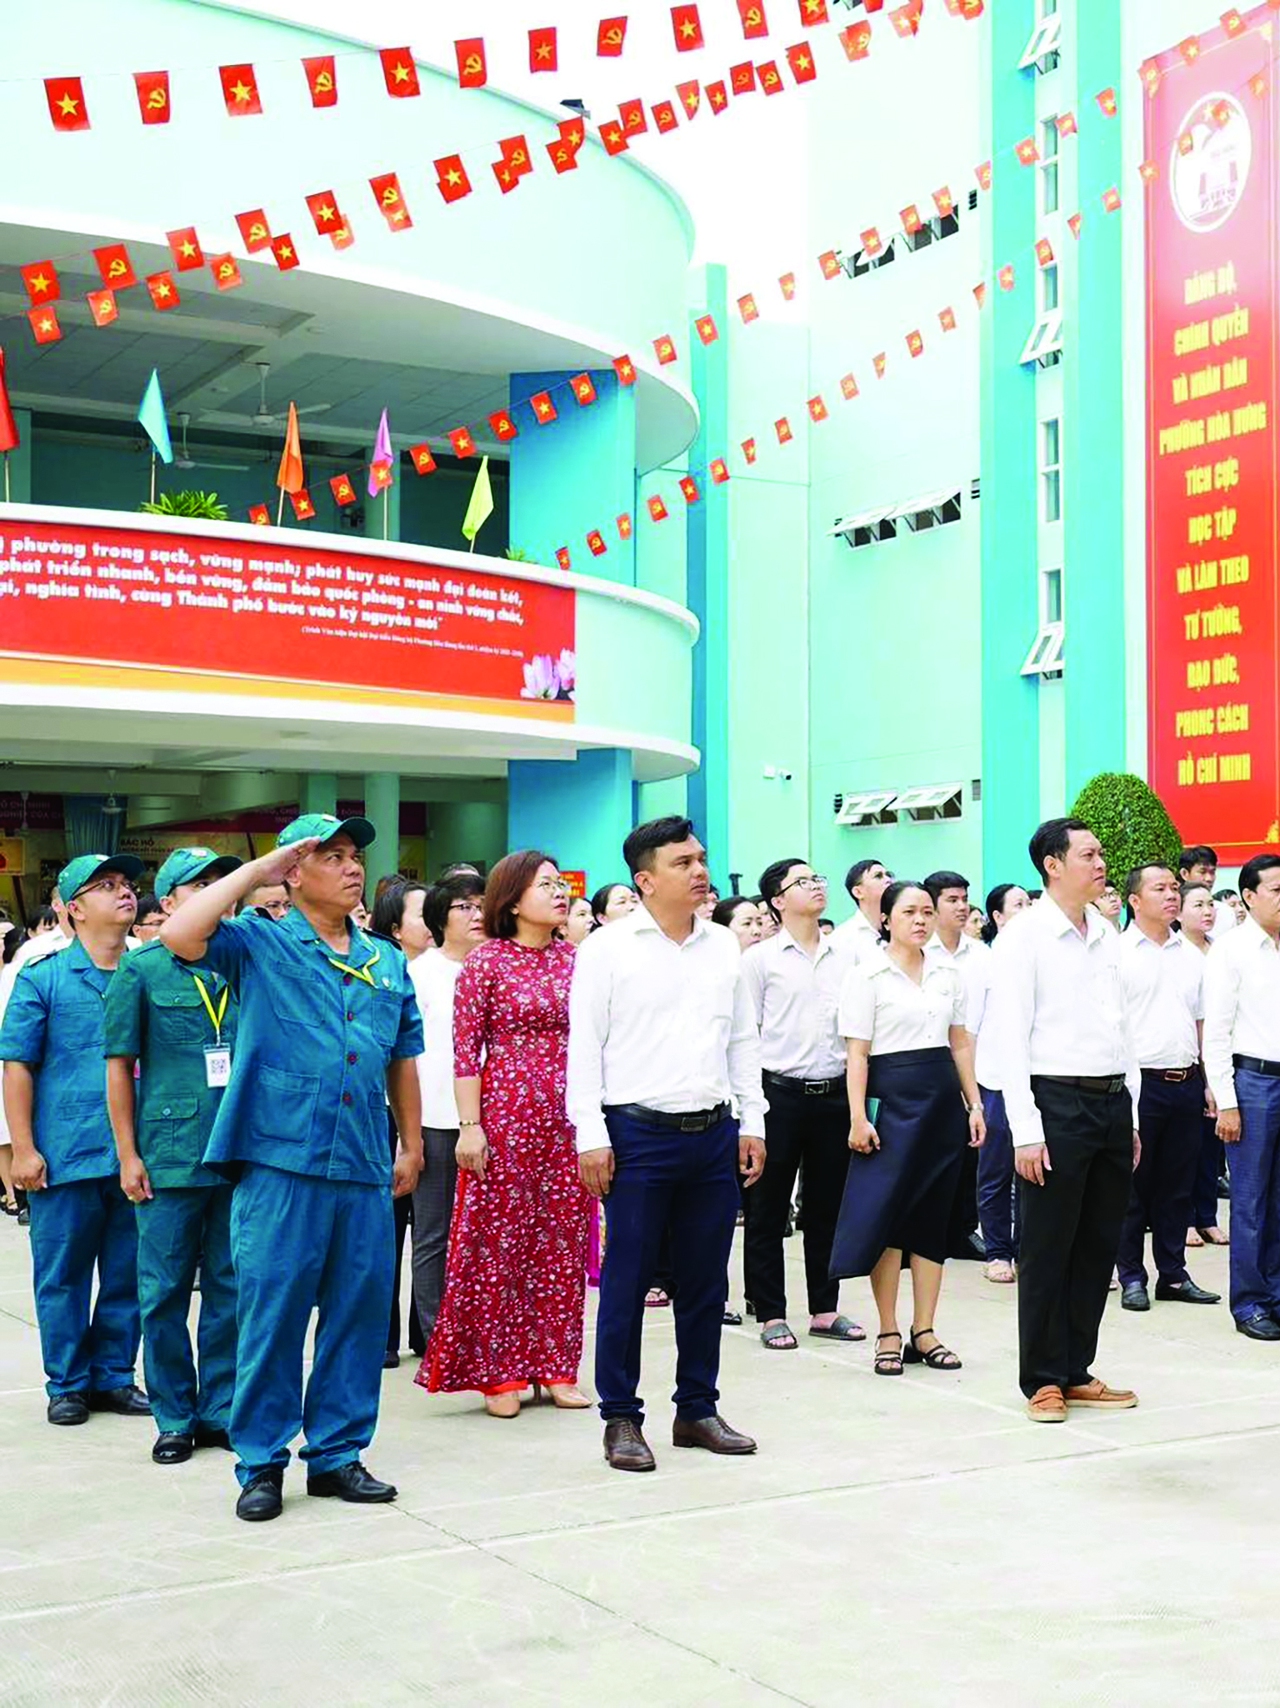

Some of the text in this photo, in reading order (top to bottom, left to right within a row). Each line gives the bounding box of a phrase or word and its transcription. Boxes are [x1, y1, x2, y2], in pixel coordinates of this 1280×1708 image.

[1185, 464, 1212, 497] TÍCH
[1188, 505, 1237, 547] HỌC TẬP
[92, 542, 145, 563] trong
[151, 547, 196, 567] sạch,
[306, 563, 342, 580] phát
[346, 567, 374, 586] huy
[404, 577, 441, 593] mạnh
[444, 579, 464, 598] đại
[97, 563, 160, 584] nhanh,
[324, 586, 359, 601] quốc
[362, 589, 405, 609] phòng
[417, 599, 434, 611] an
[436, 600, 463, 616] ninh
[1176, 554, 1249, 594] VÀ LÀM THEO
[85, 584, 127, 604] tình,
[131, 587, 173, 607] cùng
[177, 589, 228, 609] Thành
[233, 596, 264, 613] phố
[307, 604, 336, 619] vào
[361, 610, 412, 628] nguyên
[1183, 608, 1200, 641] TƯ
[1175, 700, 1249, 740] PHONG CÁCH
[1196, 752, 1218, 785] CHÍ
[1218, 753, 1251, 782] MINH
